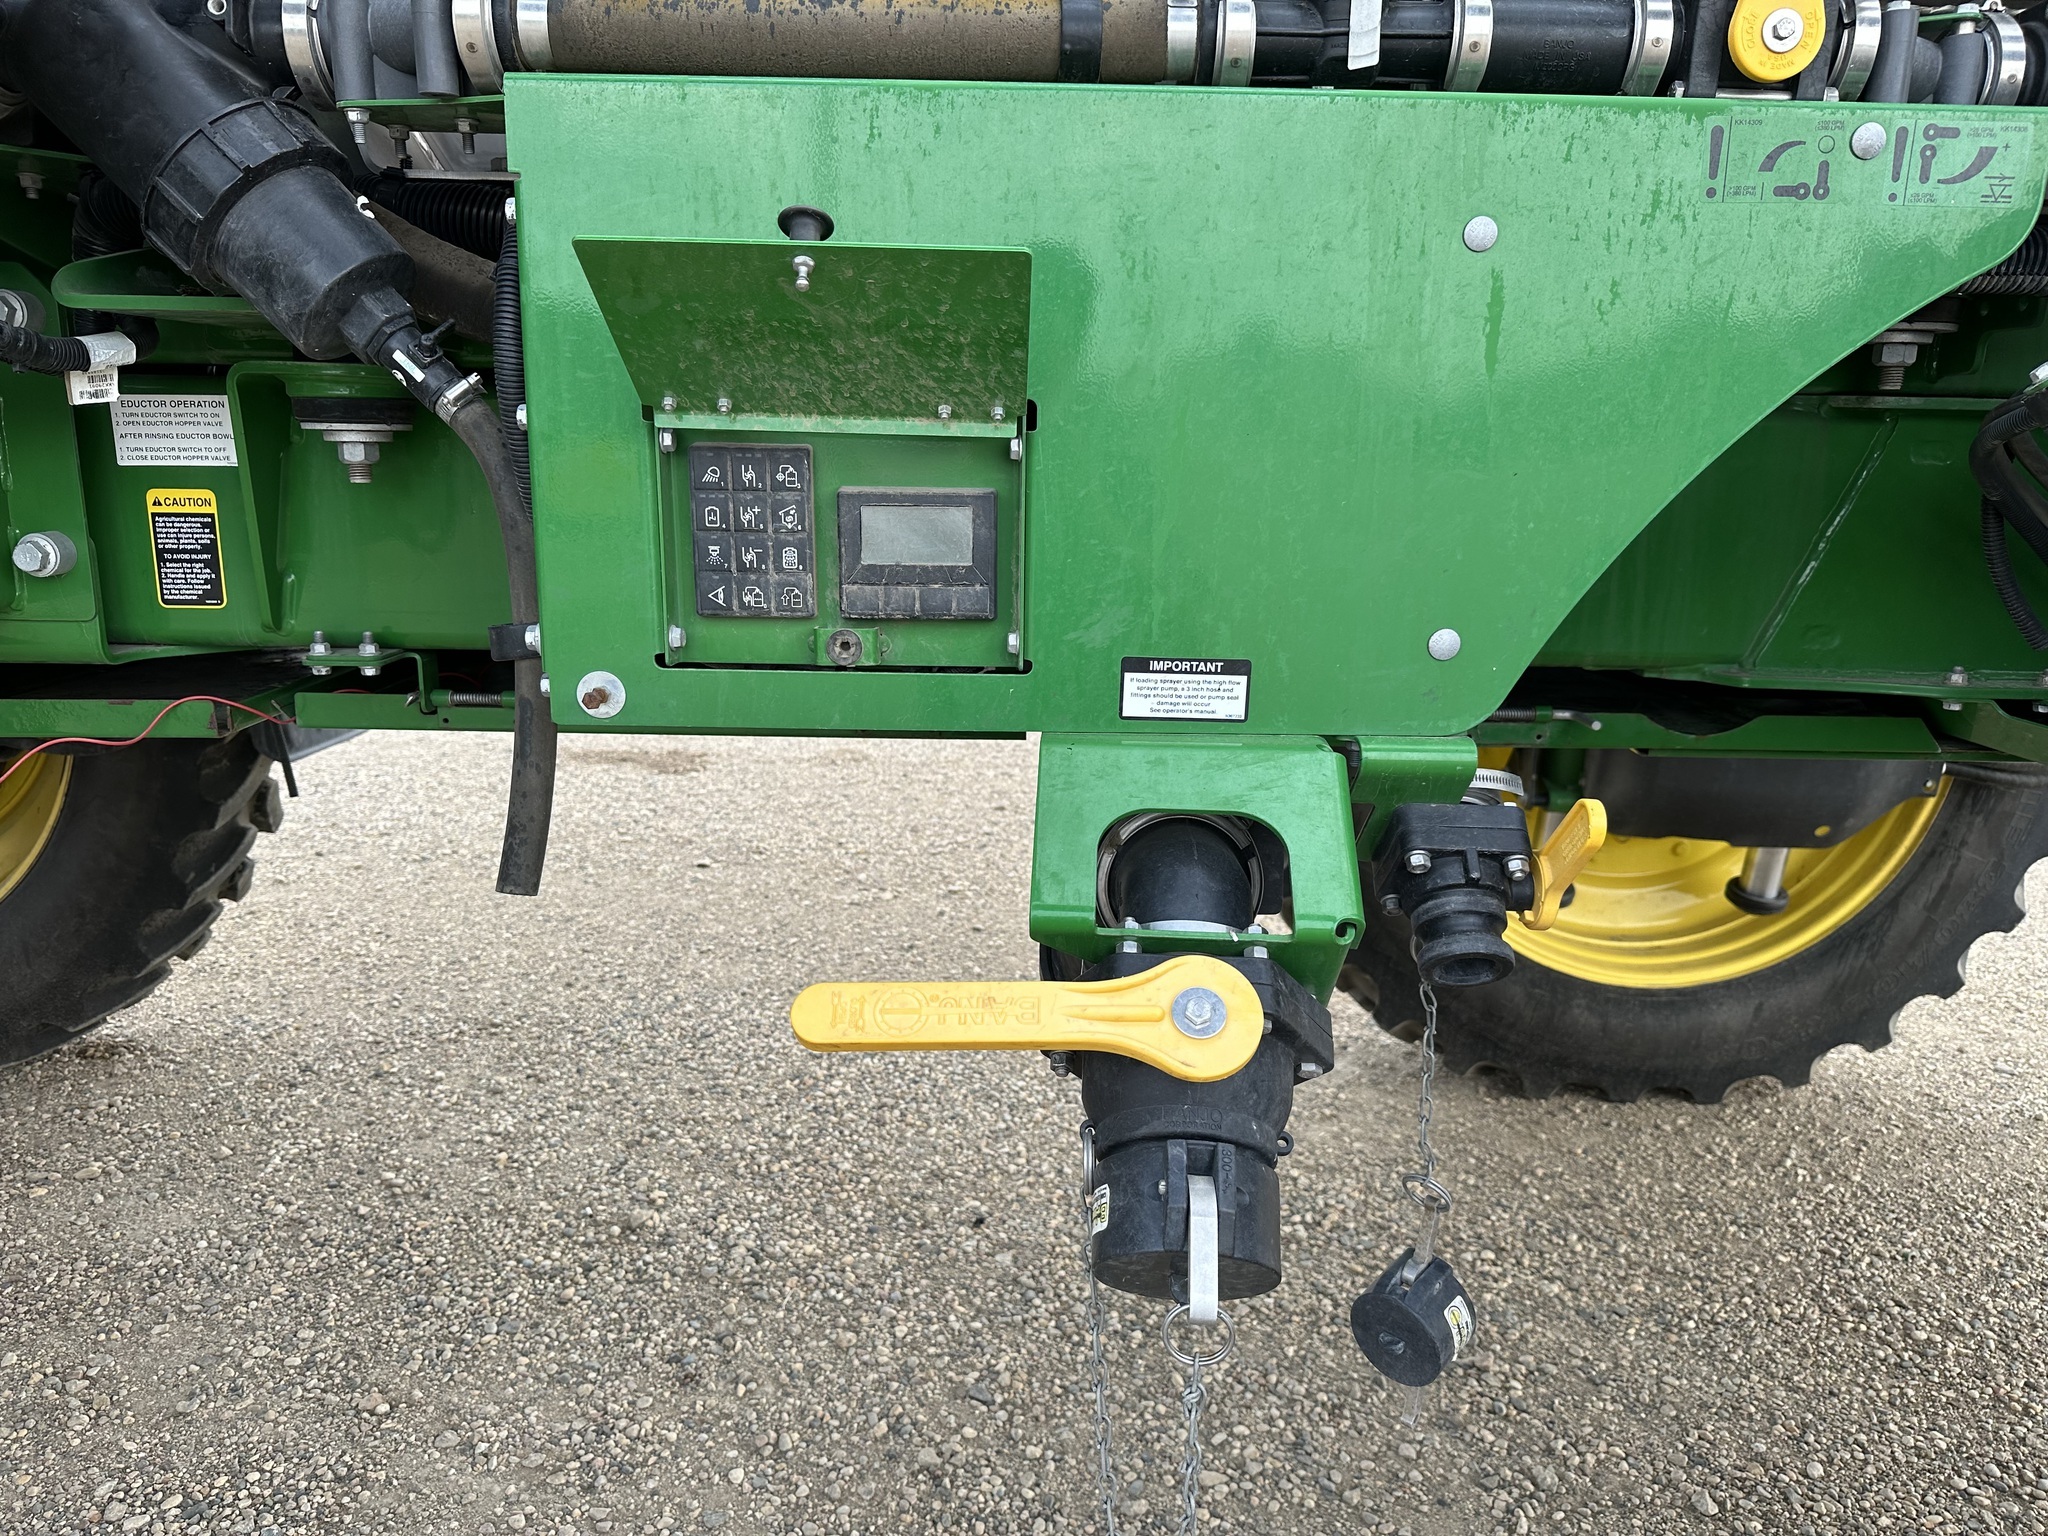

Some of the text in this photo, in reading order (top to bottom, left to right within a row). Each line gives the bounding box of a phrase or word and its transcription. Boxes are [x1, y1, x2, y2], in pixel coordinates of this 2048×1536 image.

[1801, 11, 1814, 49] OPEN
[1543, 39, 1575, 49] BANJO
[1524, 48, 1550, 59] MADE
[1572, 50, 1592, 61] USA
[121, 400, 225, 408] EDUCTOR OPERATION
[164, 497, 211, 507] CAUTION
[1149, 661, 1224, 672] IMPORTANT
